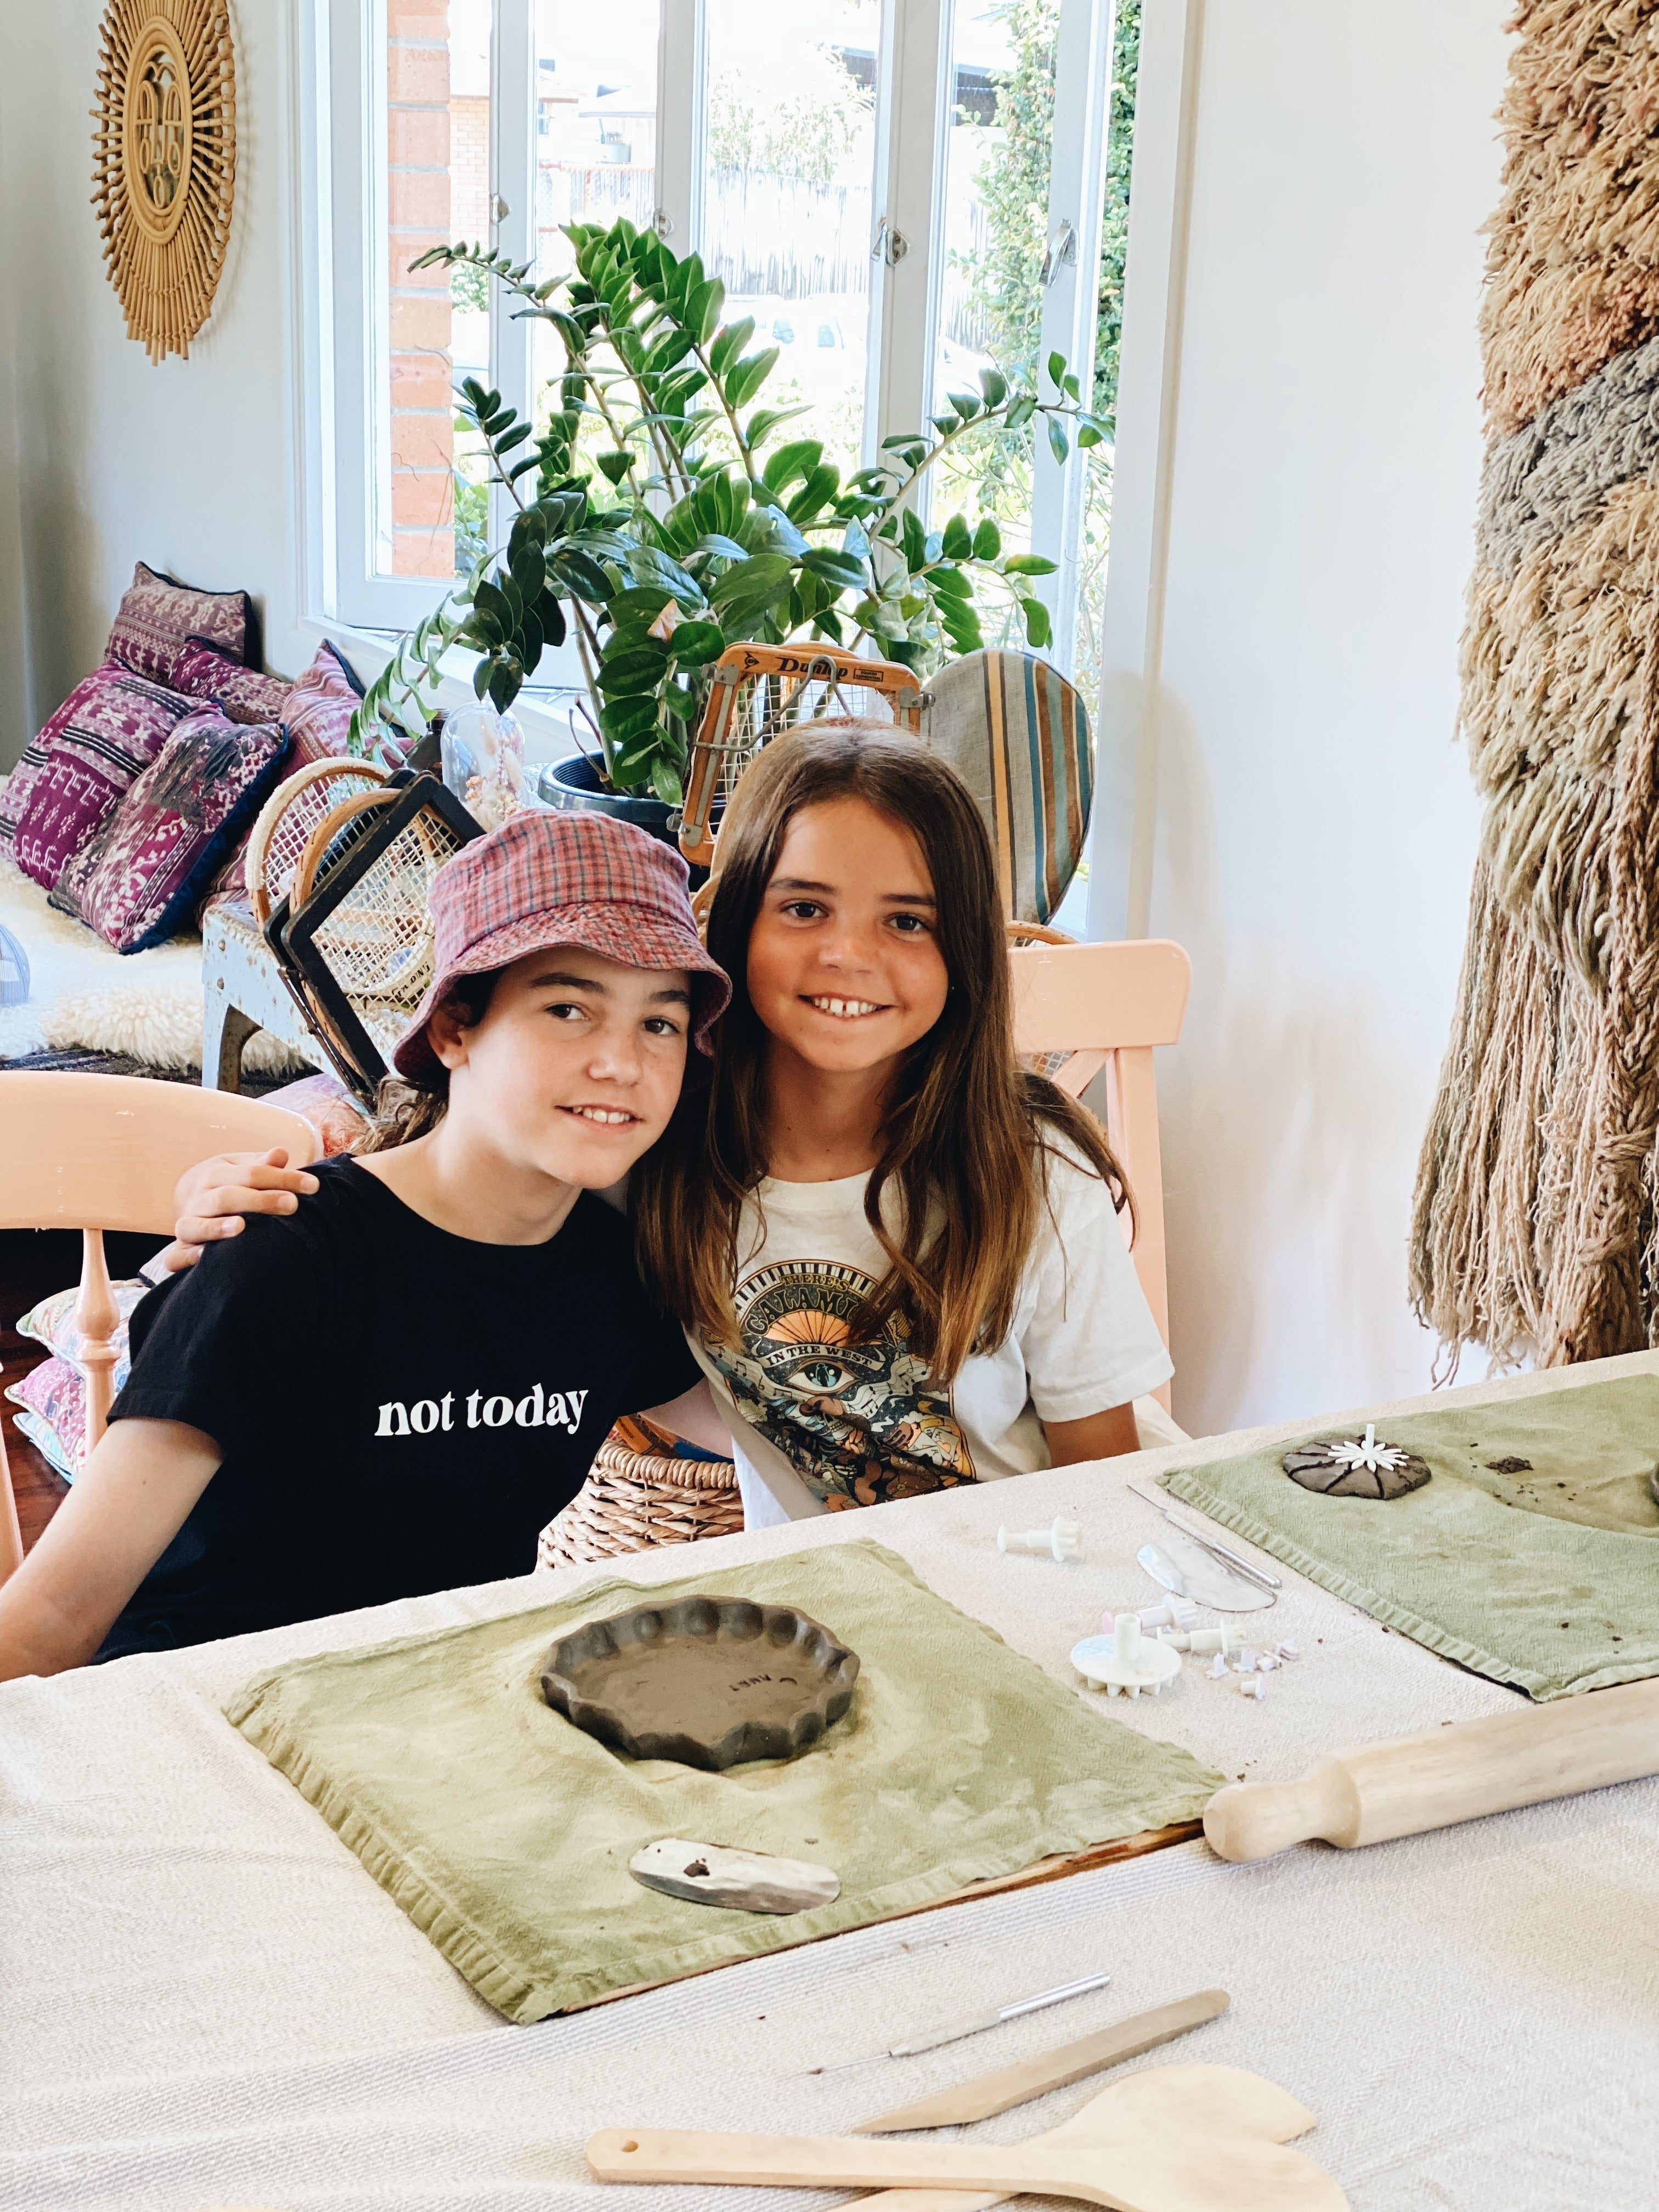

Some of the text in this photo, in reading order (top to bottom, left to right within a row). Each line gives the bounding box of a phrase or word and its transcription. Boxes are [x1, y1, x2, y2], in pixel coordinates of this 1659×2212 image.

[780, 1272, 850, 1292] THERE'S
[766, 1346, 872, 1367] IN THE WEST
[374, 1391, 455, 1436] not
[465, 1383, 589, 1435] today
